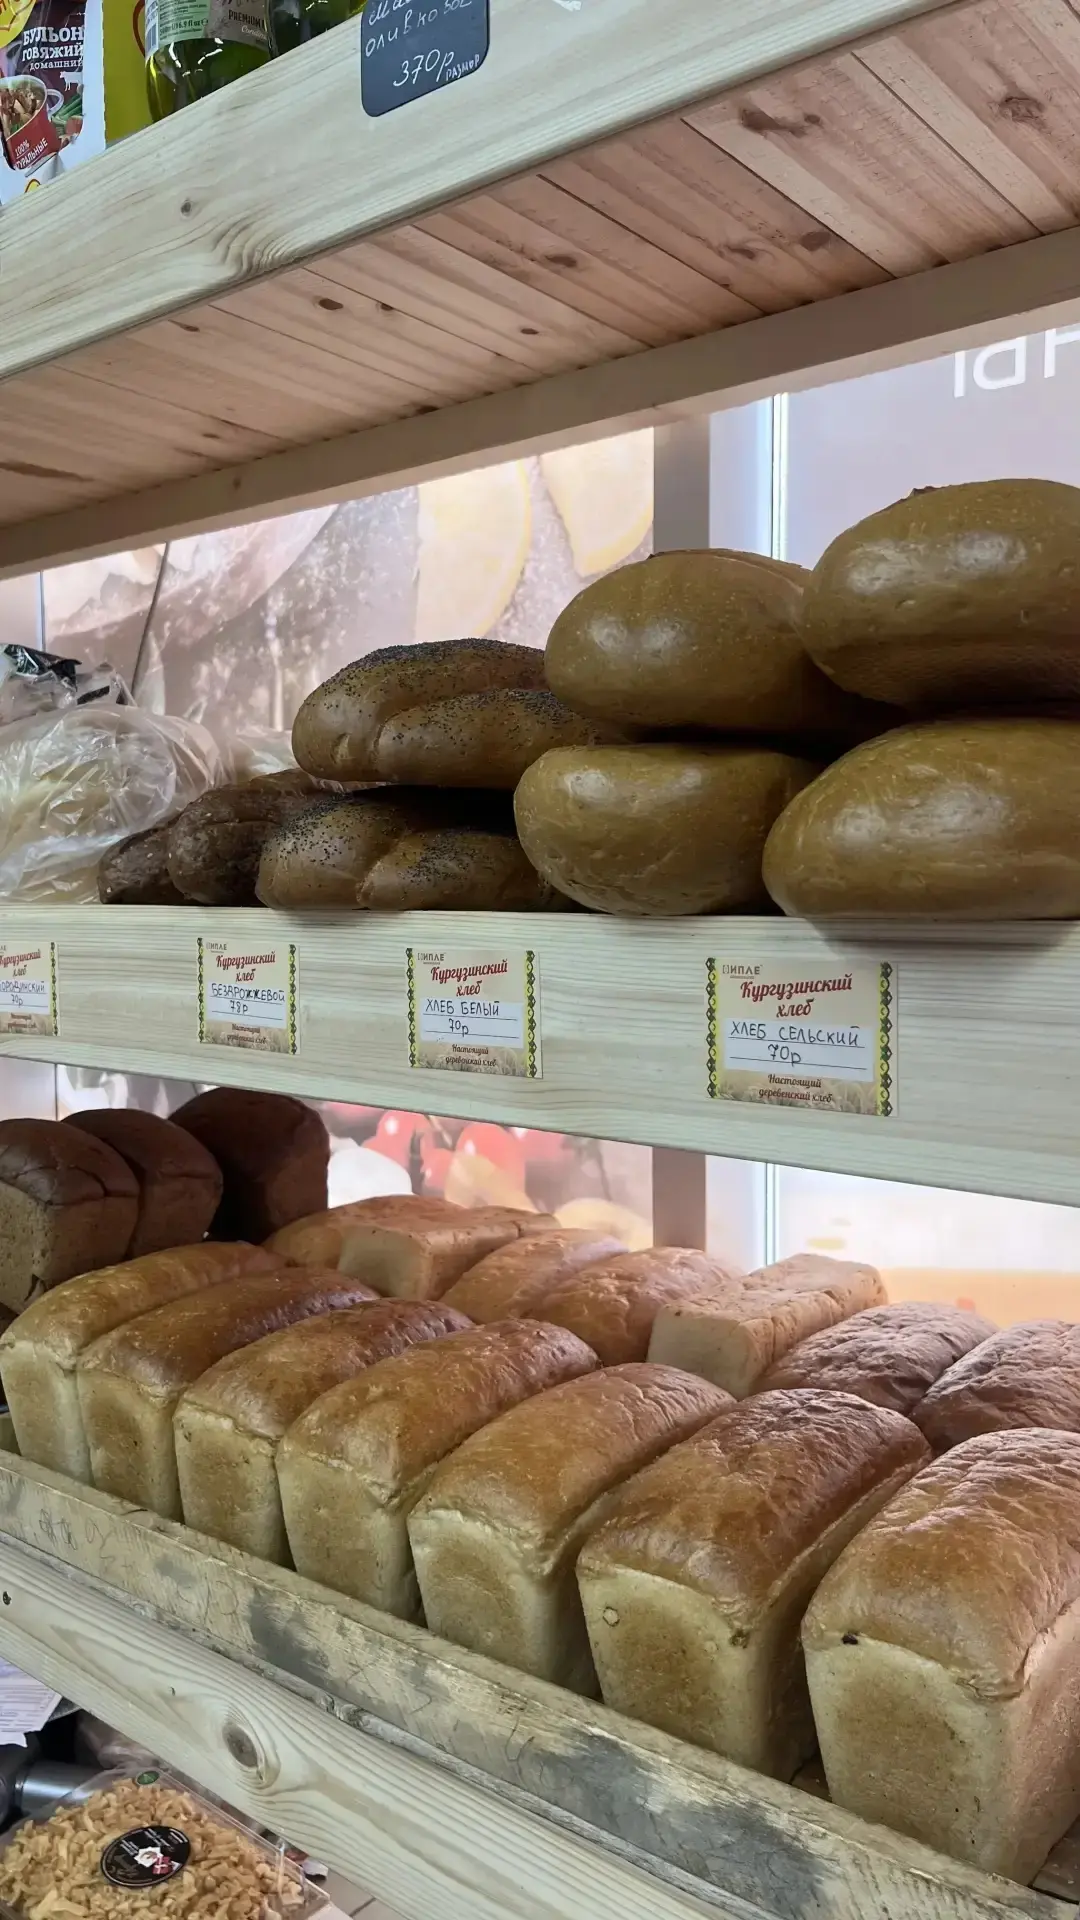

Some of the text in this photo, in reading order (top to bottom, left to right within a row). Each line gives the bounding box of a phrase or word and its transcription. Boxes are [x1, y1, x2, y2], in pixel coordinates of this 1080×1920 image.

[23, 26, 84, 46] БУЛЬОН
[22, 42, 84, 62] ГОВЯЖИЙ
[14, 137, 48, 169] ТУРАЛЬНЫЕ
[15, 139, 30, 157] 100%
[215, 951, 276, 970] Кургузинский
[430, 959, 508, 984] Кургузинский
[0, 980, 45, 993] ОРОДИНСКИЙ
[456, 980, 482, 997] хлеб
[740, 973, 853, 1002] Кургузинский
[425, 998, 501, 1016] ХЛЕБ БЕЛЫЙ
[775, 998, 815, 1018] хлеб
[730, 1020, 861, 1047] ХЛЕБ СЕЛЬСКИЙ
[767, 1073, 822, 1089] Настоящий
[758, 1087, 833, 1103] деревенский хлеб
